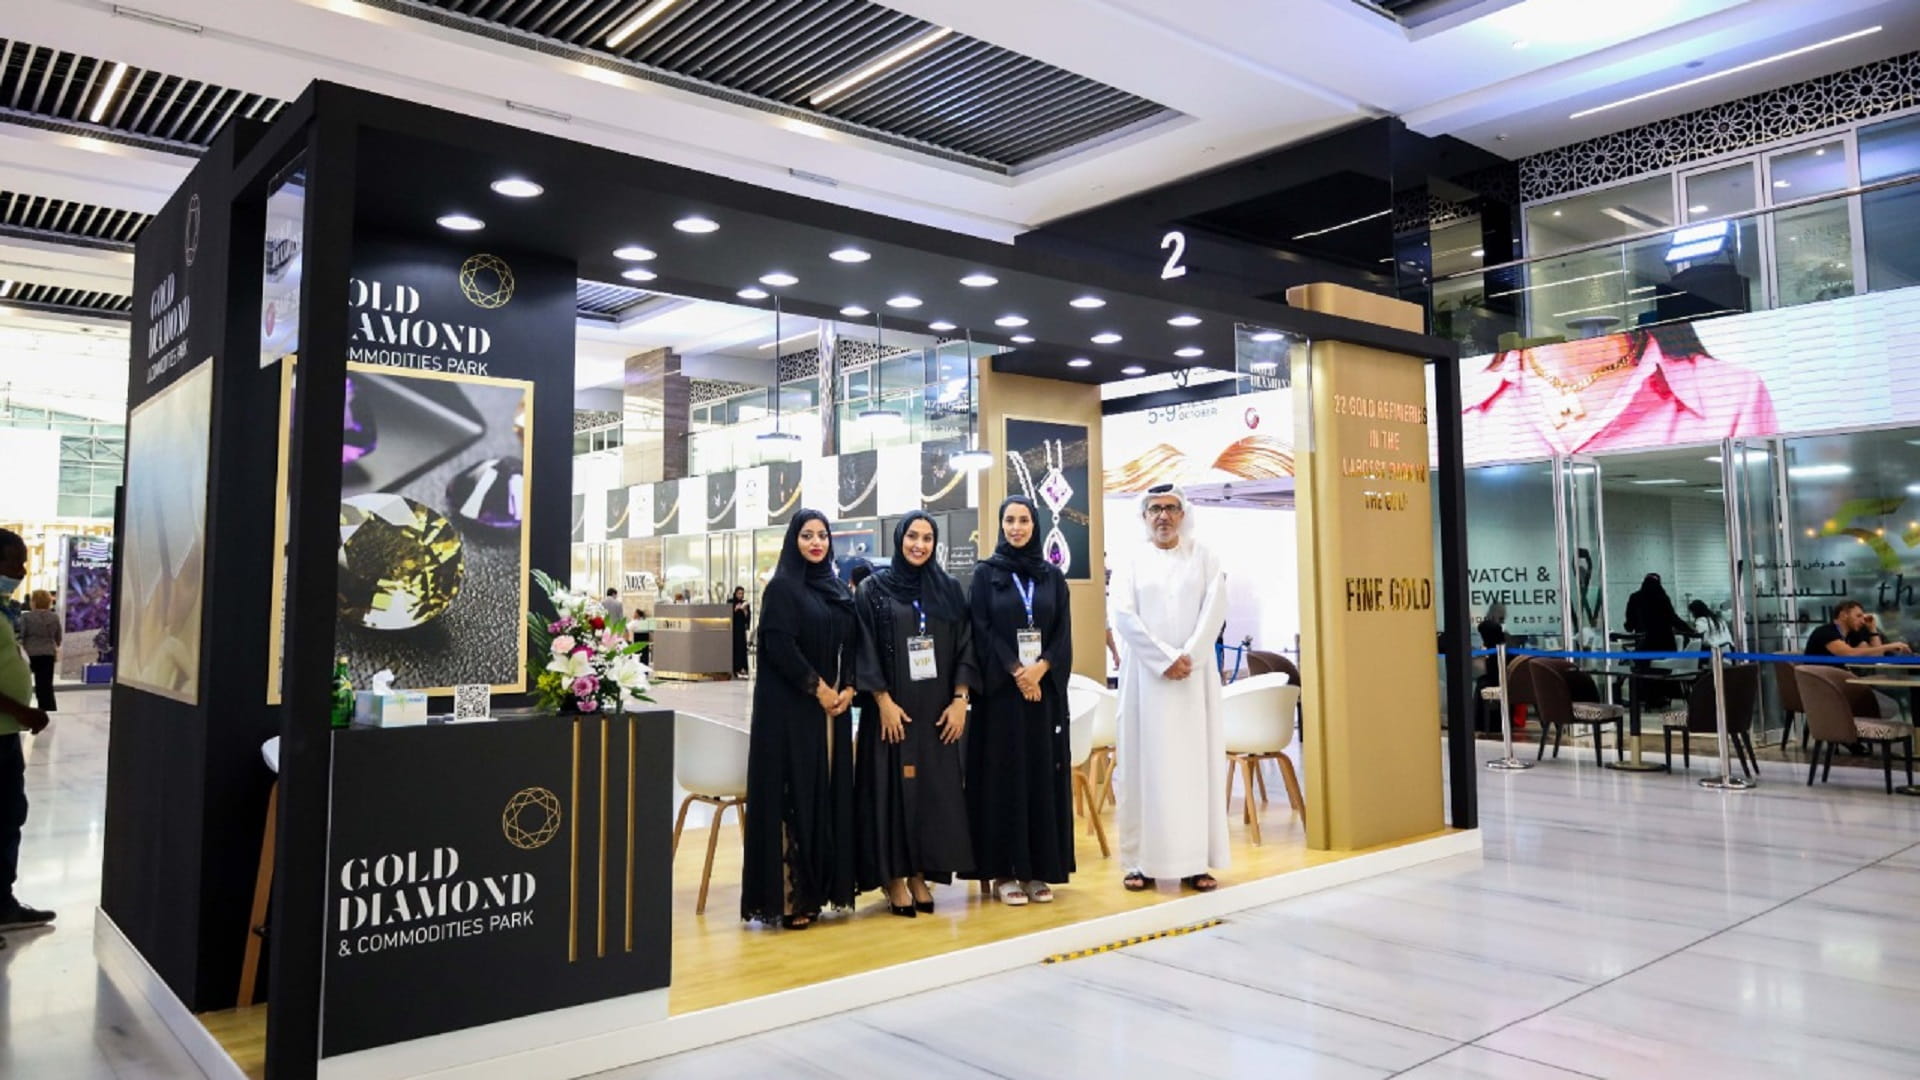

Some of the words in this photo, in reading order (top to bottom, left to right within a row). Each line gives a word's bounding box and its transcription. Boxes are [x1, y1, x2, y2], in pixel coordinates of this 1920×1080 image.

[1160, 231, 1186, 280] 2
[348, 277, 420, 314] OLD
[351, 312, 491, 355] AMOND
[349, 346, 443, 372] MMODITIES
[447, 358, 488, 376] PARK
[1334, 394, 1347, 415] 22
[1349, 396, 1376, 418] GOLD
[1369, 430, 1379, 449] IN
[1382, 431, 1401, 451] THE
[1536, 566, 1551, 582] &
[1345, 577, 1384, 613] FINE
[1390, 577, 1431, 612] GOLD
[1470, 588, 1559, 606] EWELLER
[914, 656, 931, 667] VIP
[340, 847, 460, 892] GOLD
[339, 871, 537, 932] DIAMOND
[338, 938, 352, 957] &
[357, 917, 484, 954] COMMODITIES
[489, 909, 535, 931] PARK
